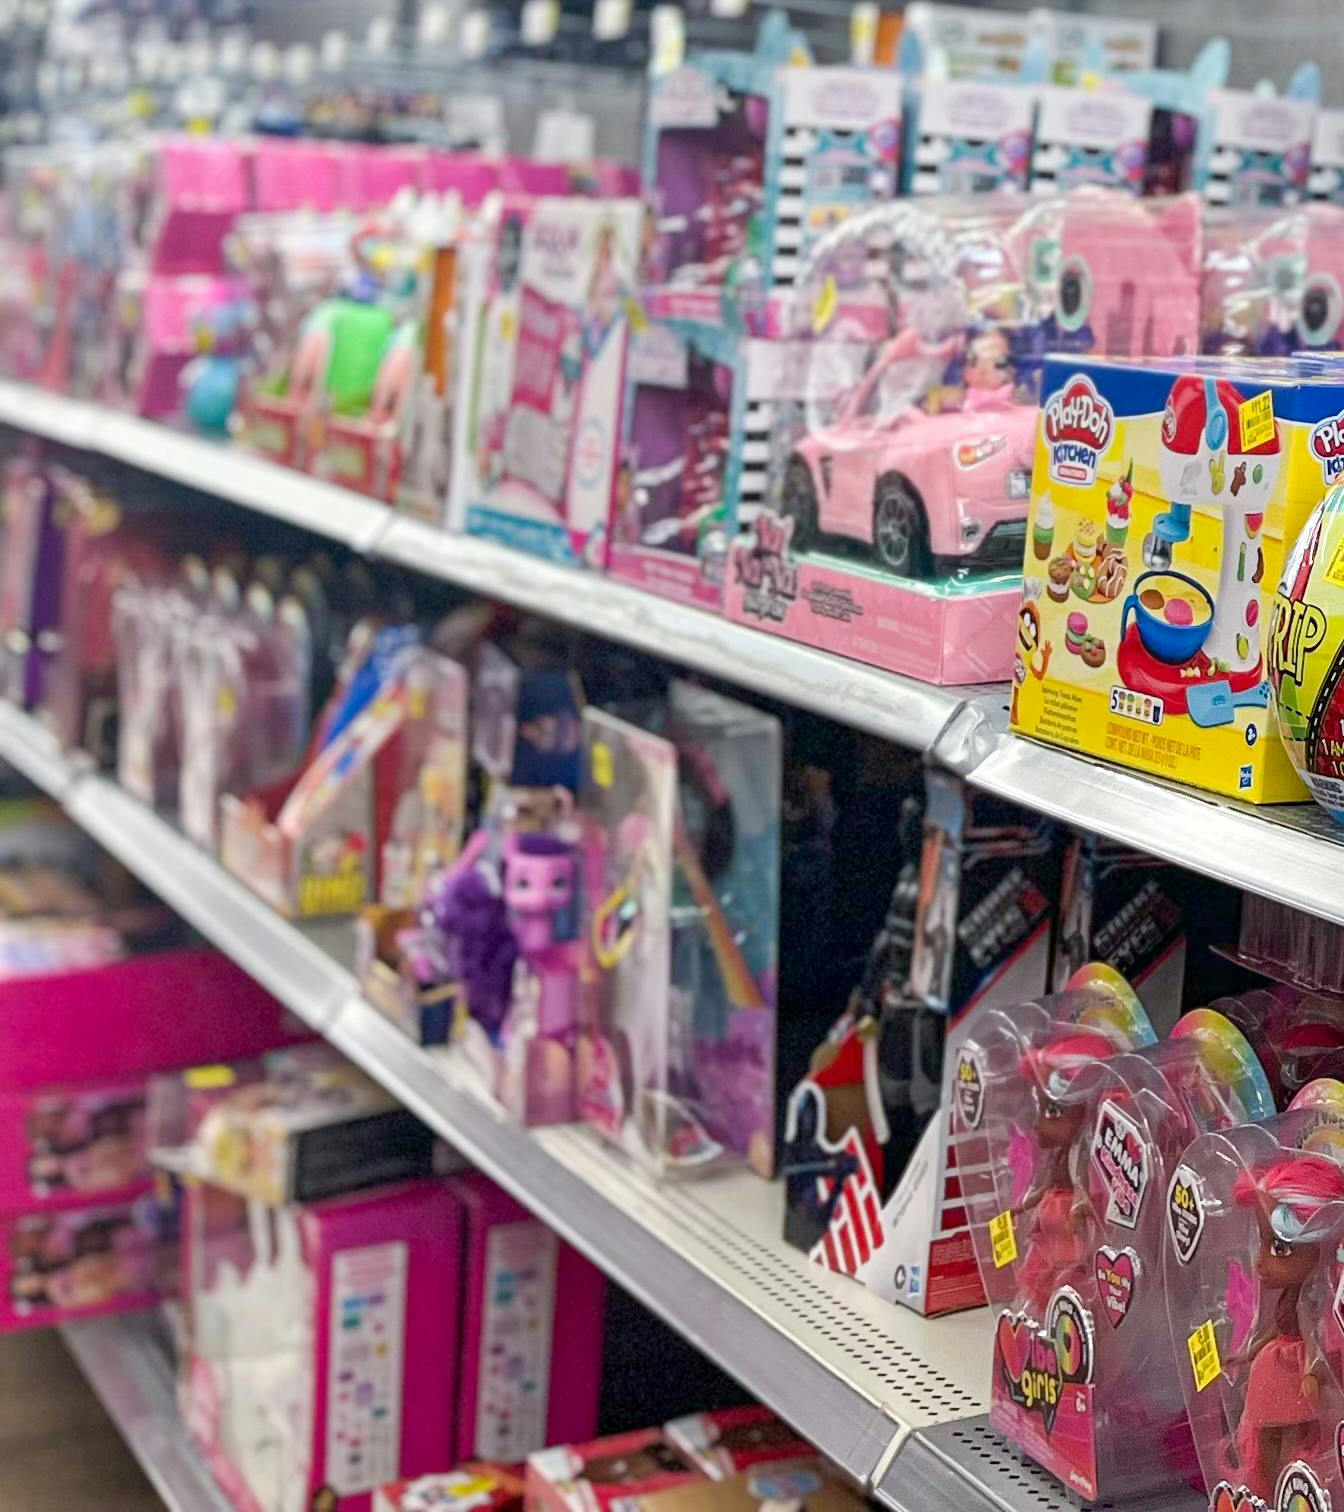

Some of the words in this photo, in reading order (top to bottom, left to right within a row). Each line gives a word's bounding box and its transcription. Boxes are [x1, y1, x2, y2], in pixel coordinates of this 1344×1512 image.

[1050, 394, 1109, 444] Play-Doh
[1110, 688, 1119, 710] 5
[1321, 738, 1328, 757] 1
[1103, 1127, 1142, 1189] EMMA
[1020, 1368, 1057, 1408] girls
